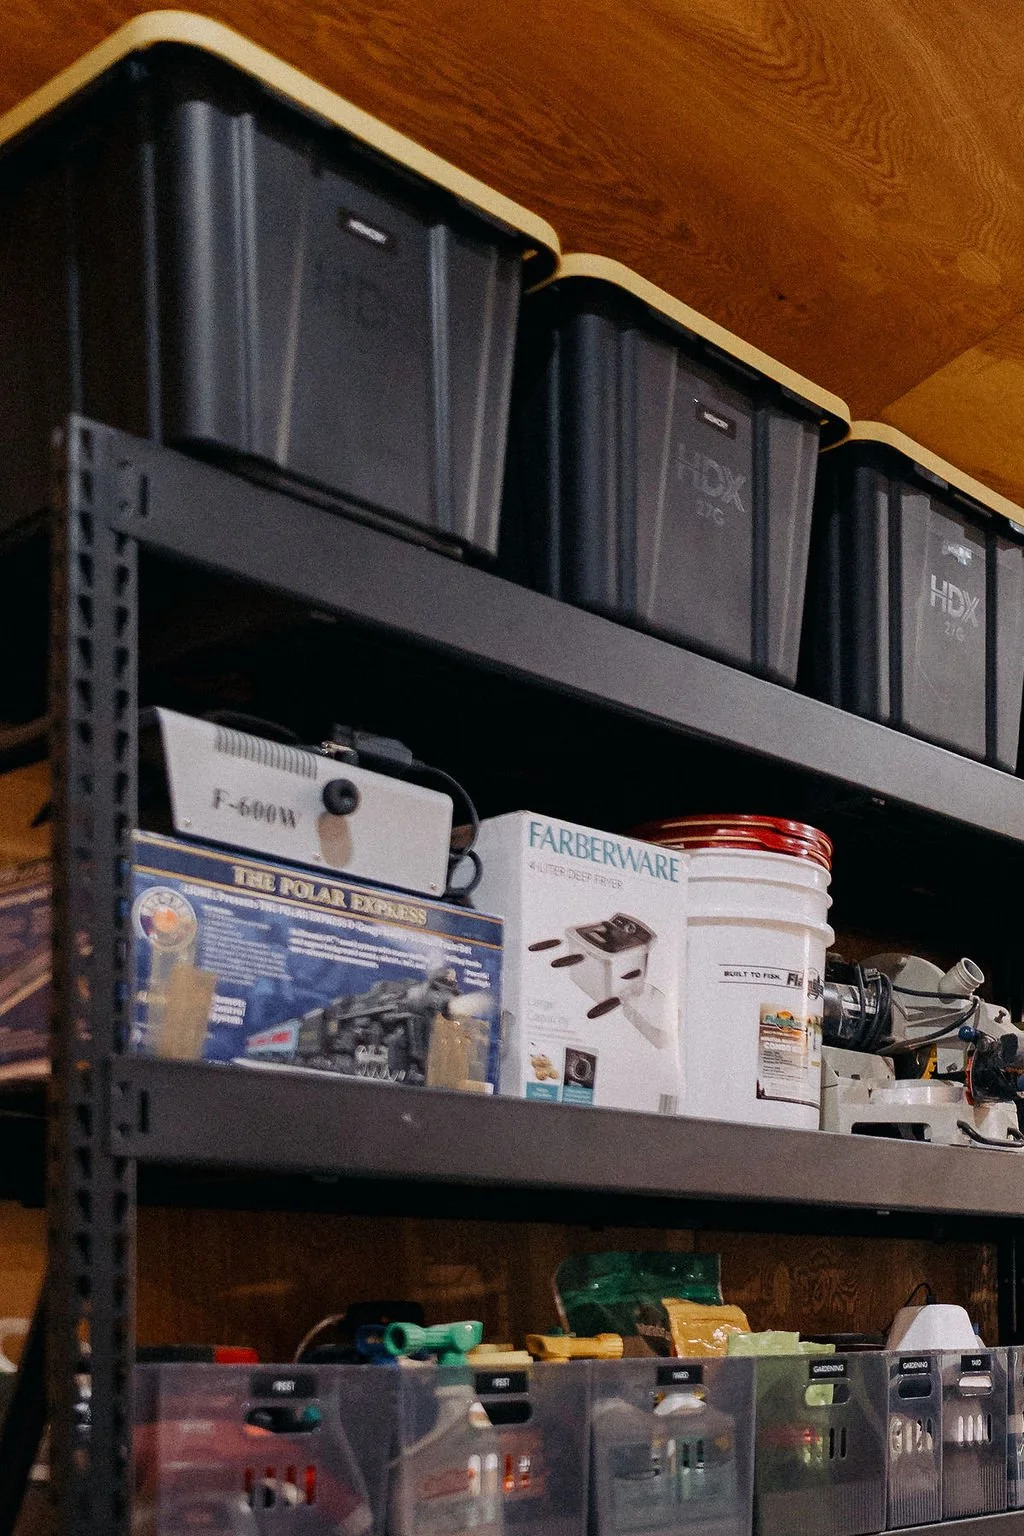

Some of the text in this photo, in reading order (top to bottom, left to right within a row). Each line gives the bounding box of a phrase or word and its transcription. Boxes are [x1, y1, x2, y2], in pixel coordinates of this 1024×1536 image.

[677, 443, 747, 513] HDX
[930, 573, 980, 628] HDX
[212, 787, 297, 830] F-600W
[528, 820, 681, 884] FARBERWARE
[231, 864, 428, 926] THE POLAR EXPRESS
[568, 867, 593, 884] DEEP
[594, 874, 625, 891] FRYER
[723, 970, 748, 978] BUILT
[750, 971, 761, 979] TO
[812, 1363, 845, 1374] GARDENING
[902, 1360, 929, 1370] GARDENING
